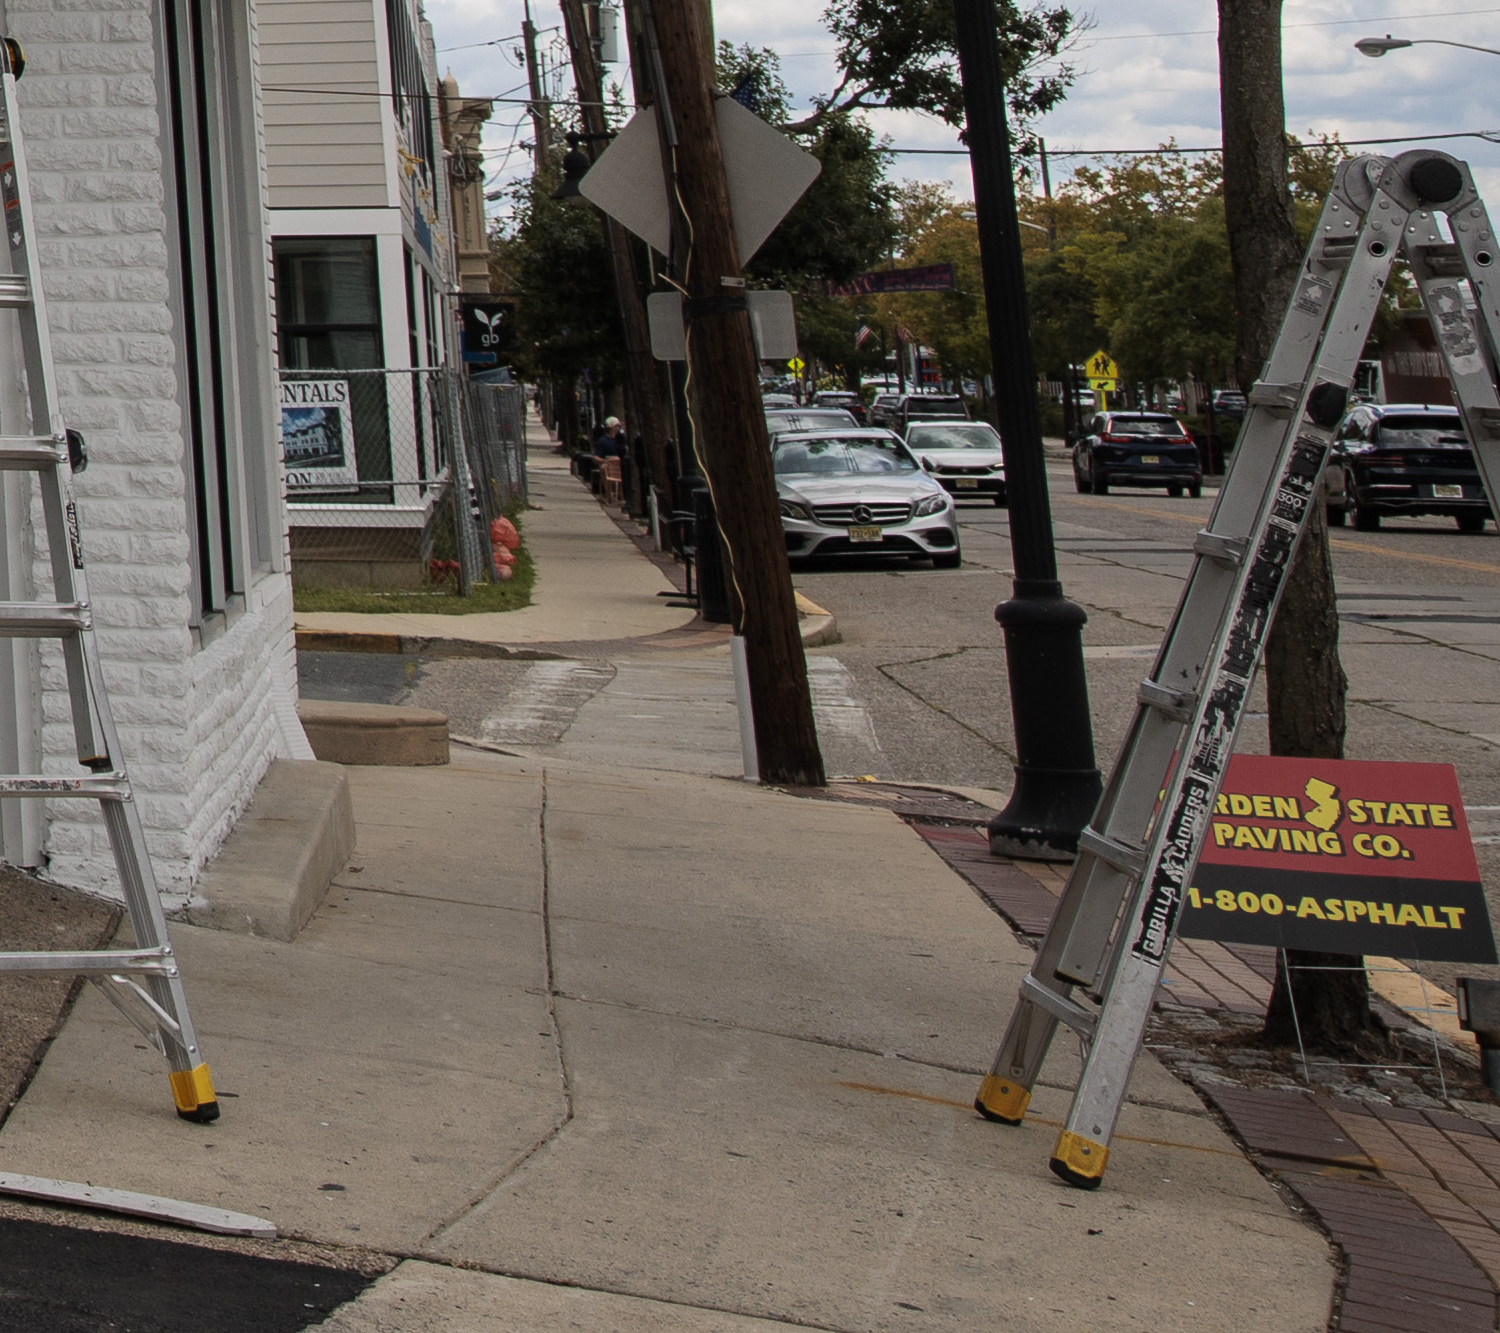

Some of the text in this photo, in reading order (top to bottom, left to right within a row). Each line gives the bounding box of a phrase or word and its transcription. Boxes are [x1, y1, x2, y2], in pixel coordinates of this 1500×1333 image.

[280, 382, 347, 403] NTALS
[1176, 786, 1205, 861] LADDERS
[1212, 792, 1455, 828] RDEN STATE
[1211, 821, 1413, 860] PAVING CO.
[1186, 886, 1466, 931] 1-800-ASPHALT
